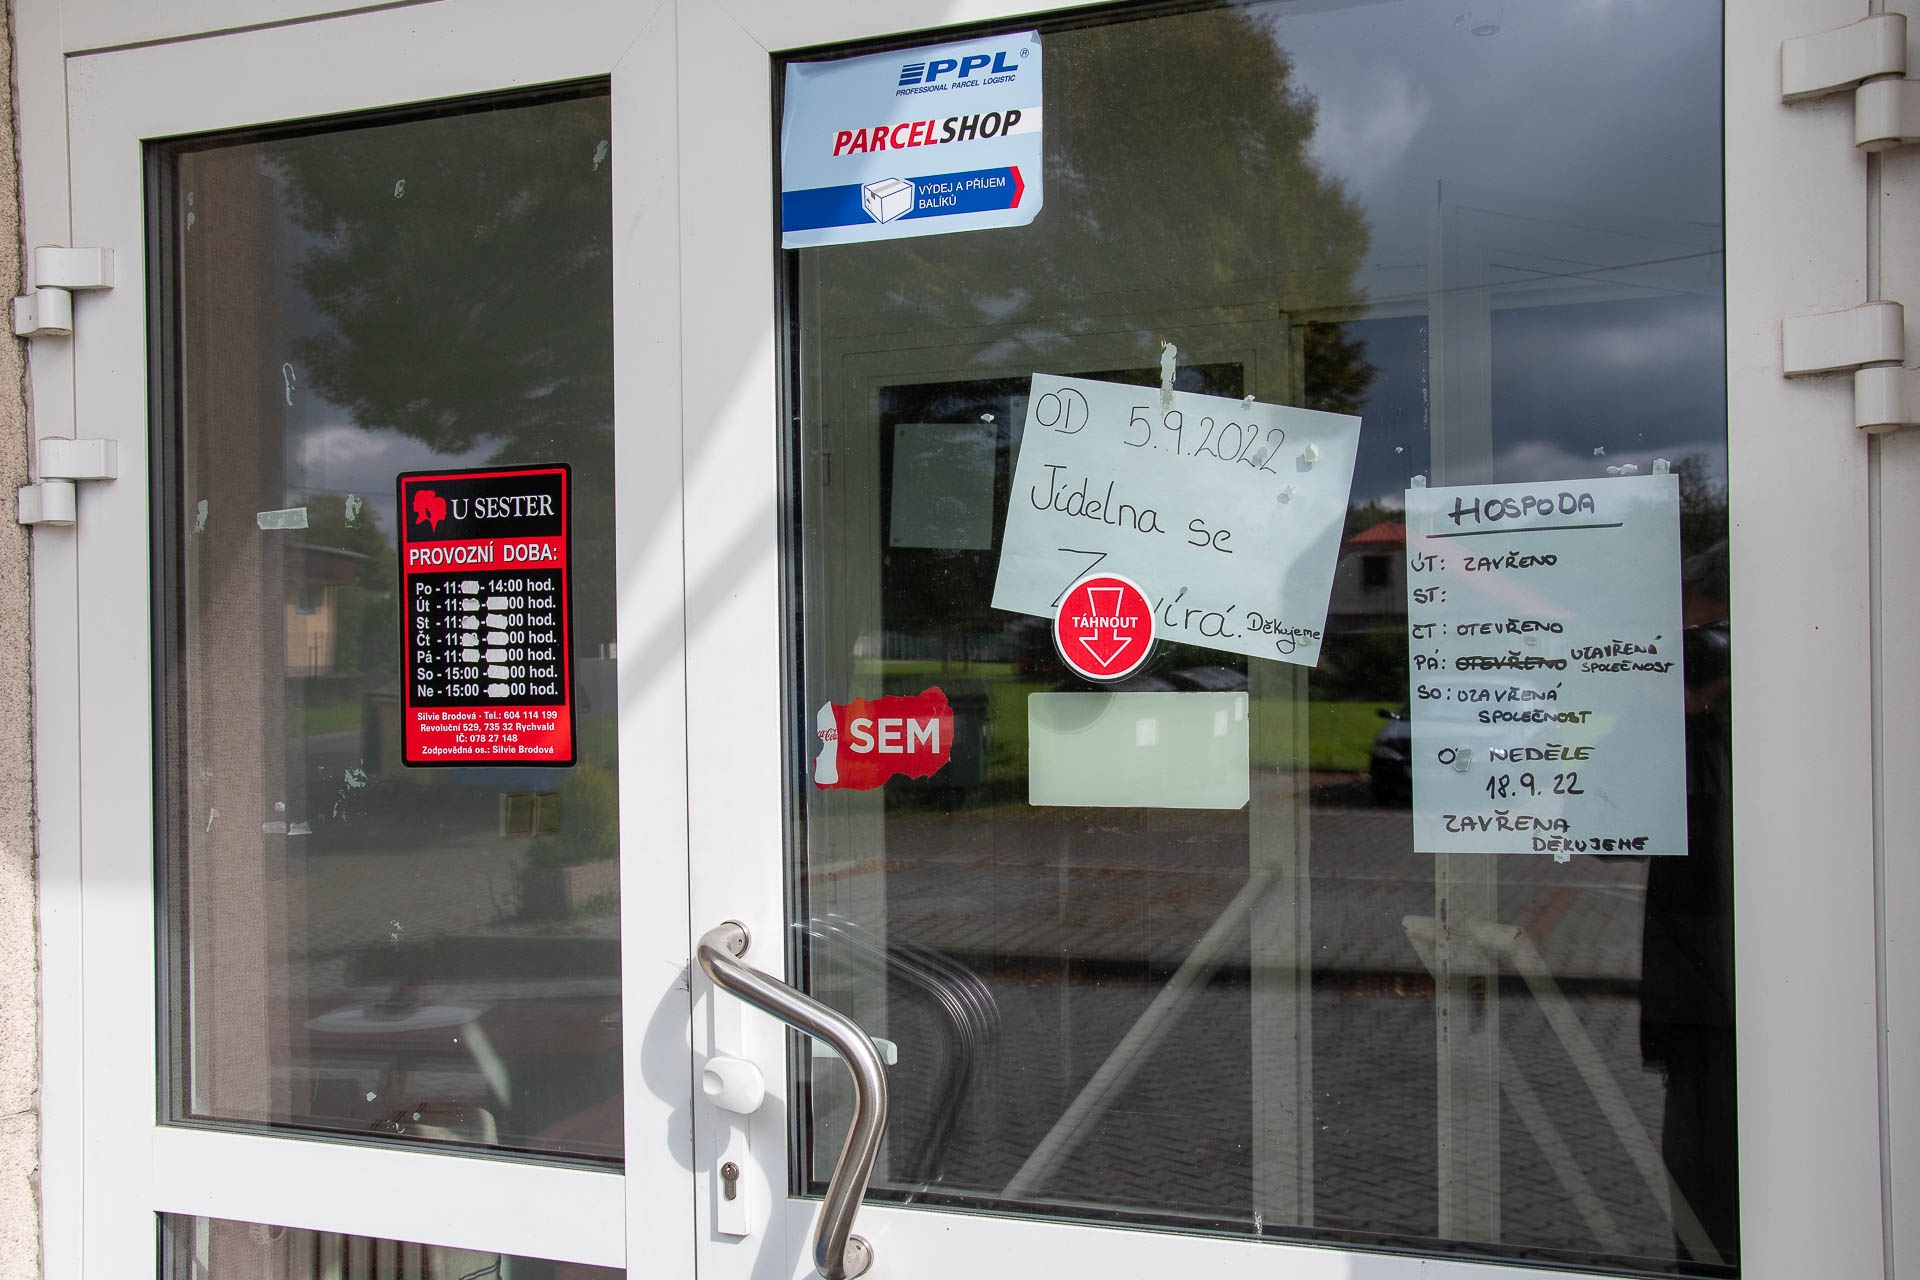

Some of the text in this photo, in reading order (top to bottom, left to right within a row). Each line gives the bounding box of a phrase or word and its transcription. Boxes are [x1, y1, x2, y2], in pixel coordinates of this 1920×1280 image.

[925, 51, 1019, 83] PPL
[896, 75, 1016, 96] PROFESSIONAL PARCEL LOGISTIC
[833, 109, 1022, 156] PARCELSHOP
[919, 176, 1006, 195] VÝDEJ A PŘÍJEM
[919, 192, 957, 209] BALÍKŮ
[1035, 387, 1286, 474] OD 5.9.2022
[451, 494, 555, 520] U SESTER
[1031, 464, 1165, 534] Jídelna
[1448, 492, 1595, 526] HOSPODA
[410, 541, 558, 566] PROVOZNÍ DOBA:
[1411, 551, 1558, 572] ÚT: ZAVŘENO
[416, 582, 432, 595] Po
[488, 579, 523, 593] 14:00
[527, 578, 555, 592] hod.
[1413, 586, 1447, 604] ST:
[416, 596, 430, 612] Út
[528, 595, 556, 609] hod.
[416, 616, 430, 630] St
[528, 613, 556, 626] hod.
[1072, 613, 1138, 628] TÁHNOUT
[1456, 618, 1564, 637] OTEVŘENO
[416, 631, 431, 646] Čt
[528, 631, 557, 644] hod.
[417, 650, 433, 663] Pá
[528, 648, 556, 661] hod.
[417, 667, 434, 680] So
[445, 667, 479, 679] 15:00
[529, 665, 558, 678] hod.
[417, 684, 434, 697] Ne
[445, 684, 479, 697] 15:00
[530, 683, 558, 696] hod.
[1417, 685, 1451, 701] SO:
[417, 712, 440, 721] Silvie
[442, 711, 477, 720] Brodová
[484, 711, 501, 720] Tel.:
[504, 711, 520, 719] 604
[523, 711, 539, 719] 114
[541, 711, 558, 719] 199
[1478, 709, 1593, 724] SPOLEČNOST
[420, 722, 555, 733] Revoluční 529, 735 32 Rychvald
[849, 717, 940, 754] SEM
[456, 733, 518, 743] IČ: 078 27 148
[421, 745, 472, 756] Zodpovědná
[492, 745, 516, 754] Silvie
[518, 745, 554, 754] Brodová
[1490, 743, 1596, 762] NEDĚLE
[1443, 810, 1571, 833] ZAVŘENA
